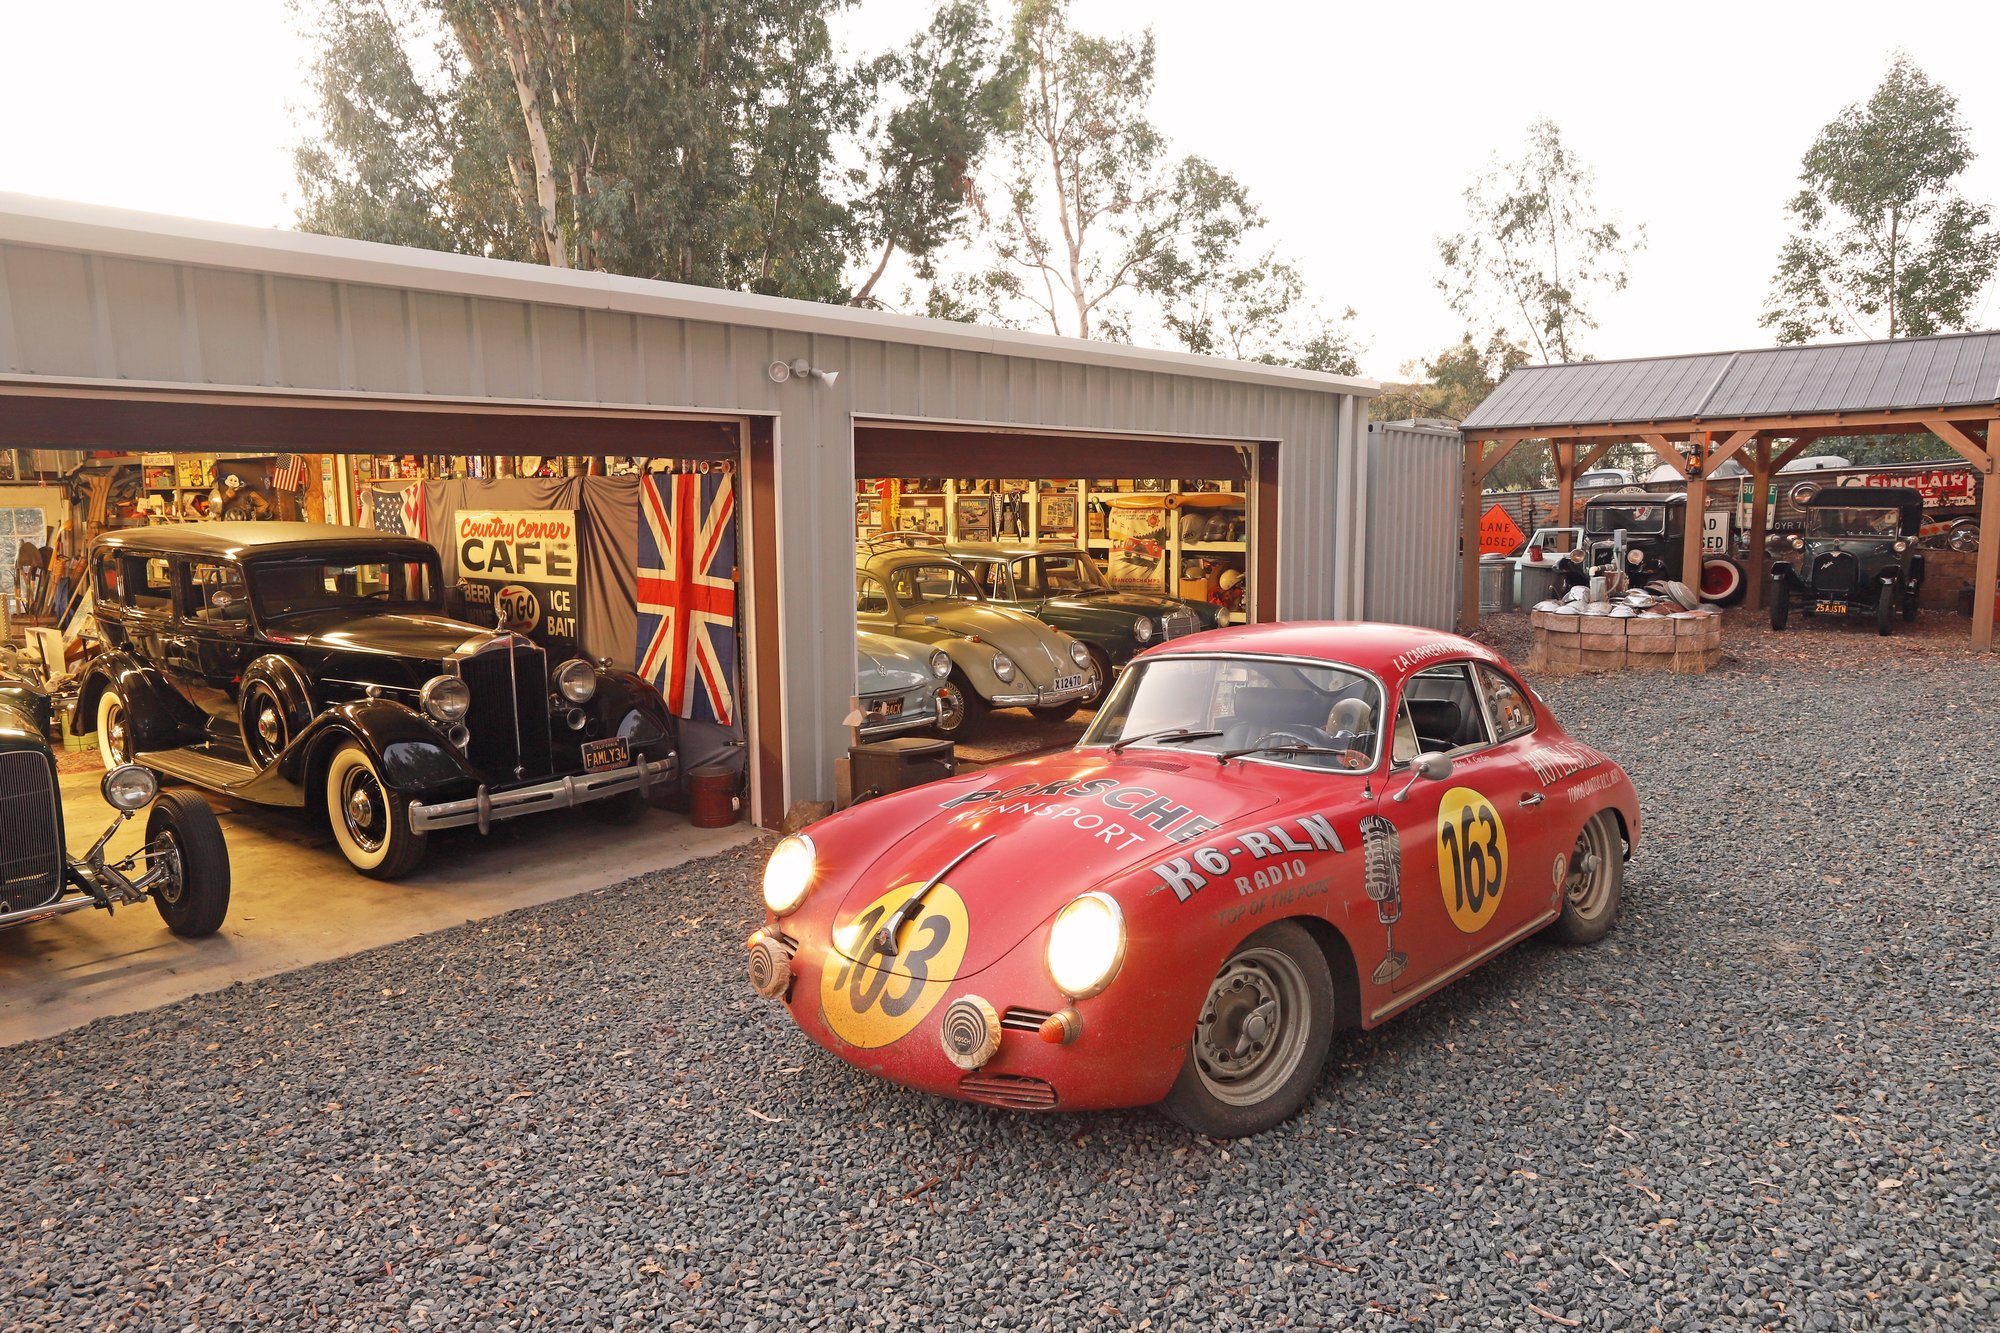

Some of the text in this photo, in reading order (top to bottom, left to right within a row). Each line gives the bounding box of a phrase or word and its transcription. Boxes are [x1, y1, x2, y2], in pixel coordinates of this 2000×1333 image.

[1869, 475, 1964, 489] SINCLAIR
[461, 517, 571, 546] Country Corner
[1480, 522, 1510, 532] LANE
[1480, 536, 1515, 547] LOSED
[461, 538, 573, 577] CAFE
[464, 584, 491, 604] BEER
[516, 594, 535, 620] GO
[550, 590, 571, 612] ICE
[547, 616, 576, 638] BAIT
[1393, 655, 1410, 673] LA
[1406, 642, 1448, 665] CARRERA
[1055, 675, 1082, 690] X12470
[586, 747, 627, 768] FAMLY34
[938, 778, 1223, 845] PORSCHE
[947, 802, 1145, 851] RENNSPORT
[1151, 813, 1345, 904] K6-RLN
[1442, 805, 1502, 913] 163
[1234, 859, 1307, 896] RADIO
[1250, 901, 1266, 916] OF
[1271, 890, 1295, 907] THE
[834, 905, 951, 1017] 163
[954, 1035, 971, 1044] BOSCH
